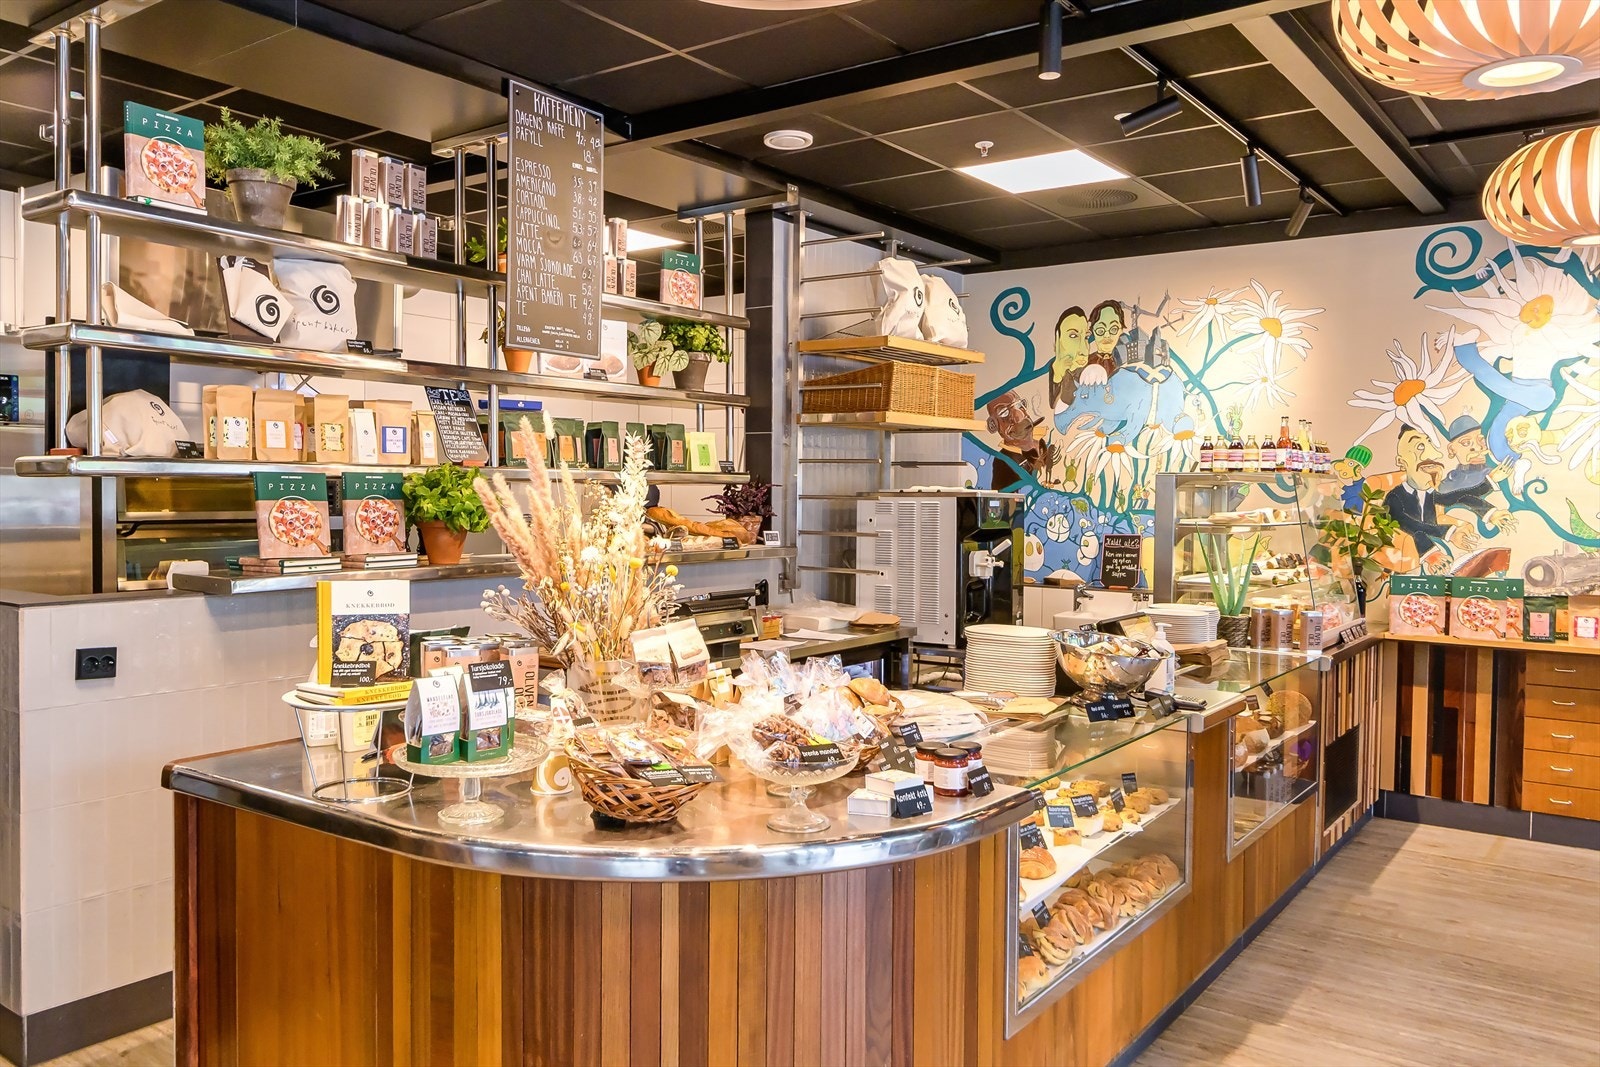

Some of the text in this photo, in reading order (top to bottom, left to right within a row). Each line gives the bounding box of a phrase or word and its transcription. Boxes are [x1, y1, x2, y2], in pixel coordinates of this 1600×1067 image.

[534, 92, 587, 130] KAFFEMENY
[142, 117, 193, 138] PIZZA
[515, 109, 543, 131] DAGENS
[547, 120, 566, 139] KAFFE
[515, 126, 543, 148] PÅFYLL
[515, 156, 552, 180] ESPRESSO
[515, 174, 556, 198] AMERICANO
[516, 253, 537, 270] VARM
[669, 257, 695, 267] PIZZA
[516, 268, 533, 284] CHAI
[516, 283, 538, 302] ÅPENT
[541, 289, 563, 307] BAKERI
[568, 294, 577, 309] TE
[516, 300, 527, 316] TE
[439, 388, 459, 401] TE
[268, 483, 316, 491] PIZZA
[1460, 585, 1499, 593] PIZZA
[470, 663, 505, 673] Tursjokolade
[497, 675, 513, 686] 79,-
[801, 747, 840, 757] brente mandler
[896, 792, 917, 803] Konfekt
